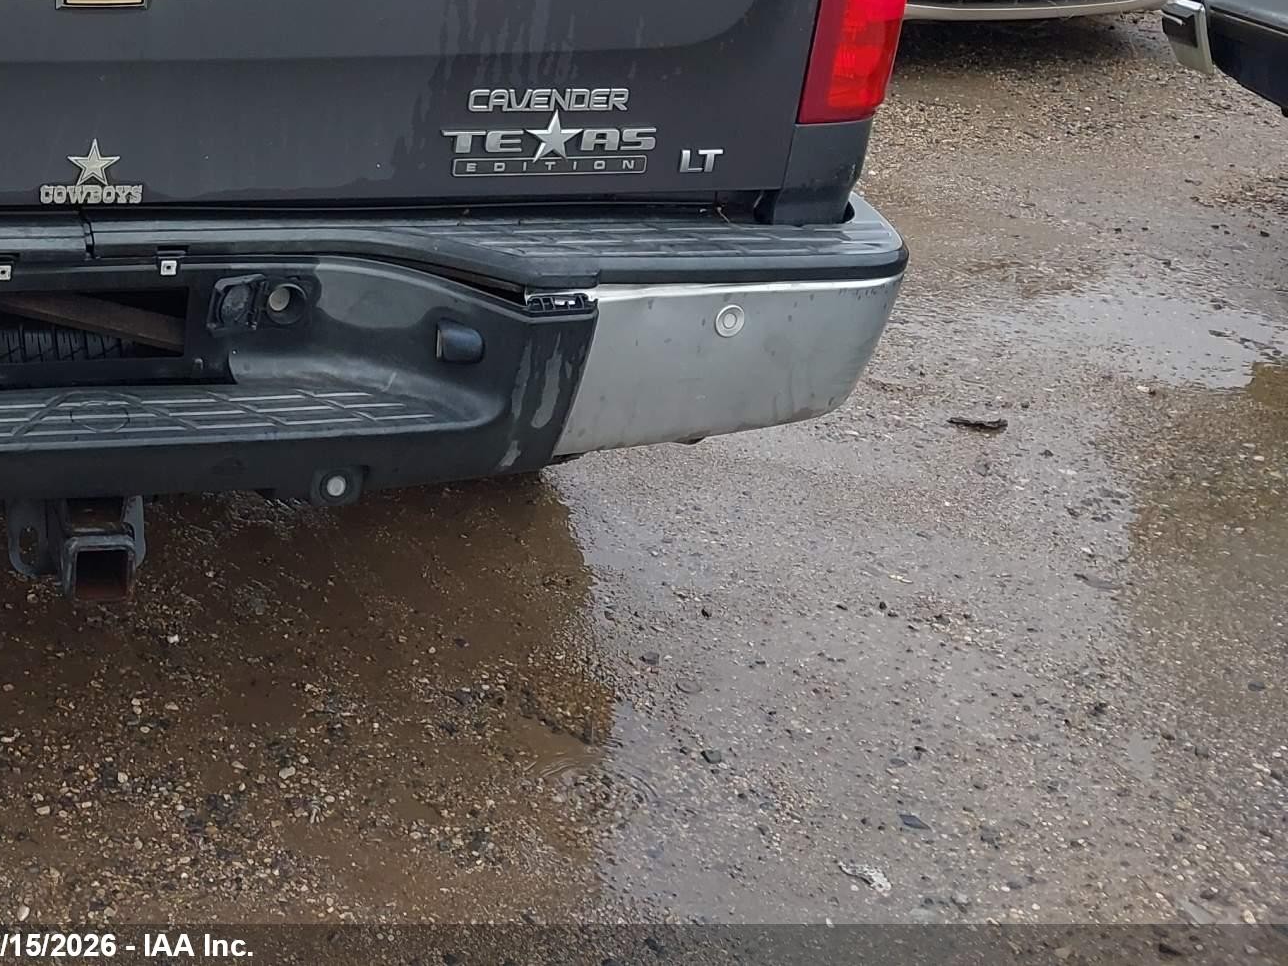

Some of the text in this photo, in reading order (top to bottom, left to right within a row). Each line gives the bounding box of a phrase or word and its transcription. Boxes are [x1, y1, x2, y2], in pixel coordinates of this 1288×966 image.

[468, 88, 629, 113] CAVENDER
[465, 159, 636, 173] EDITION
[679, 149, 724, 173] LT
[39, 184, 144, 204] COWBOYS
